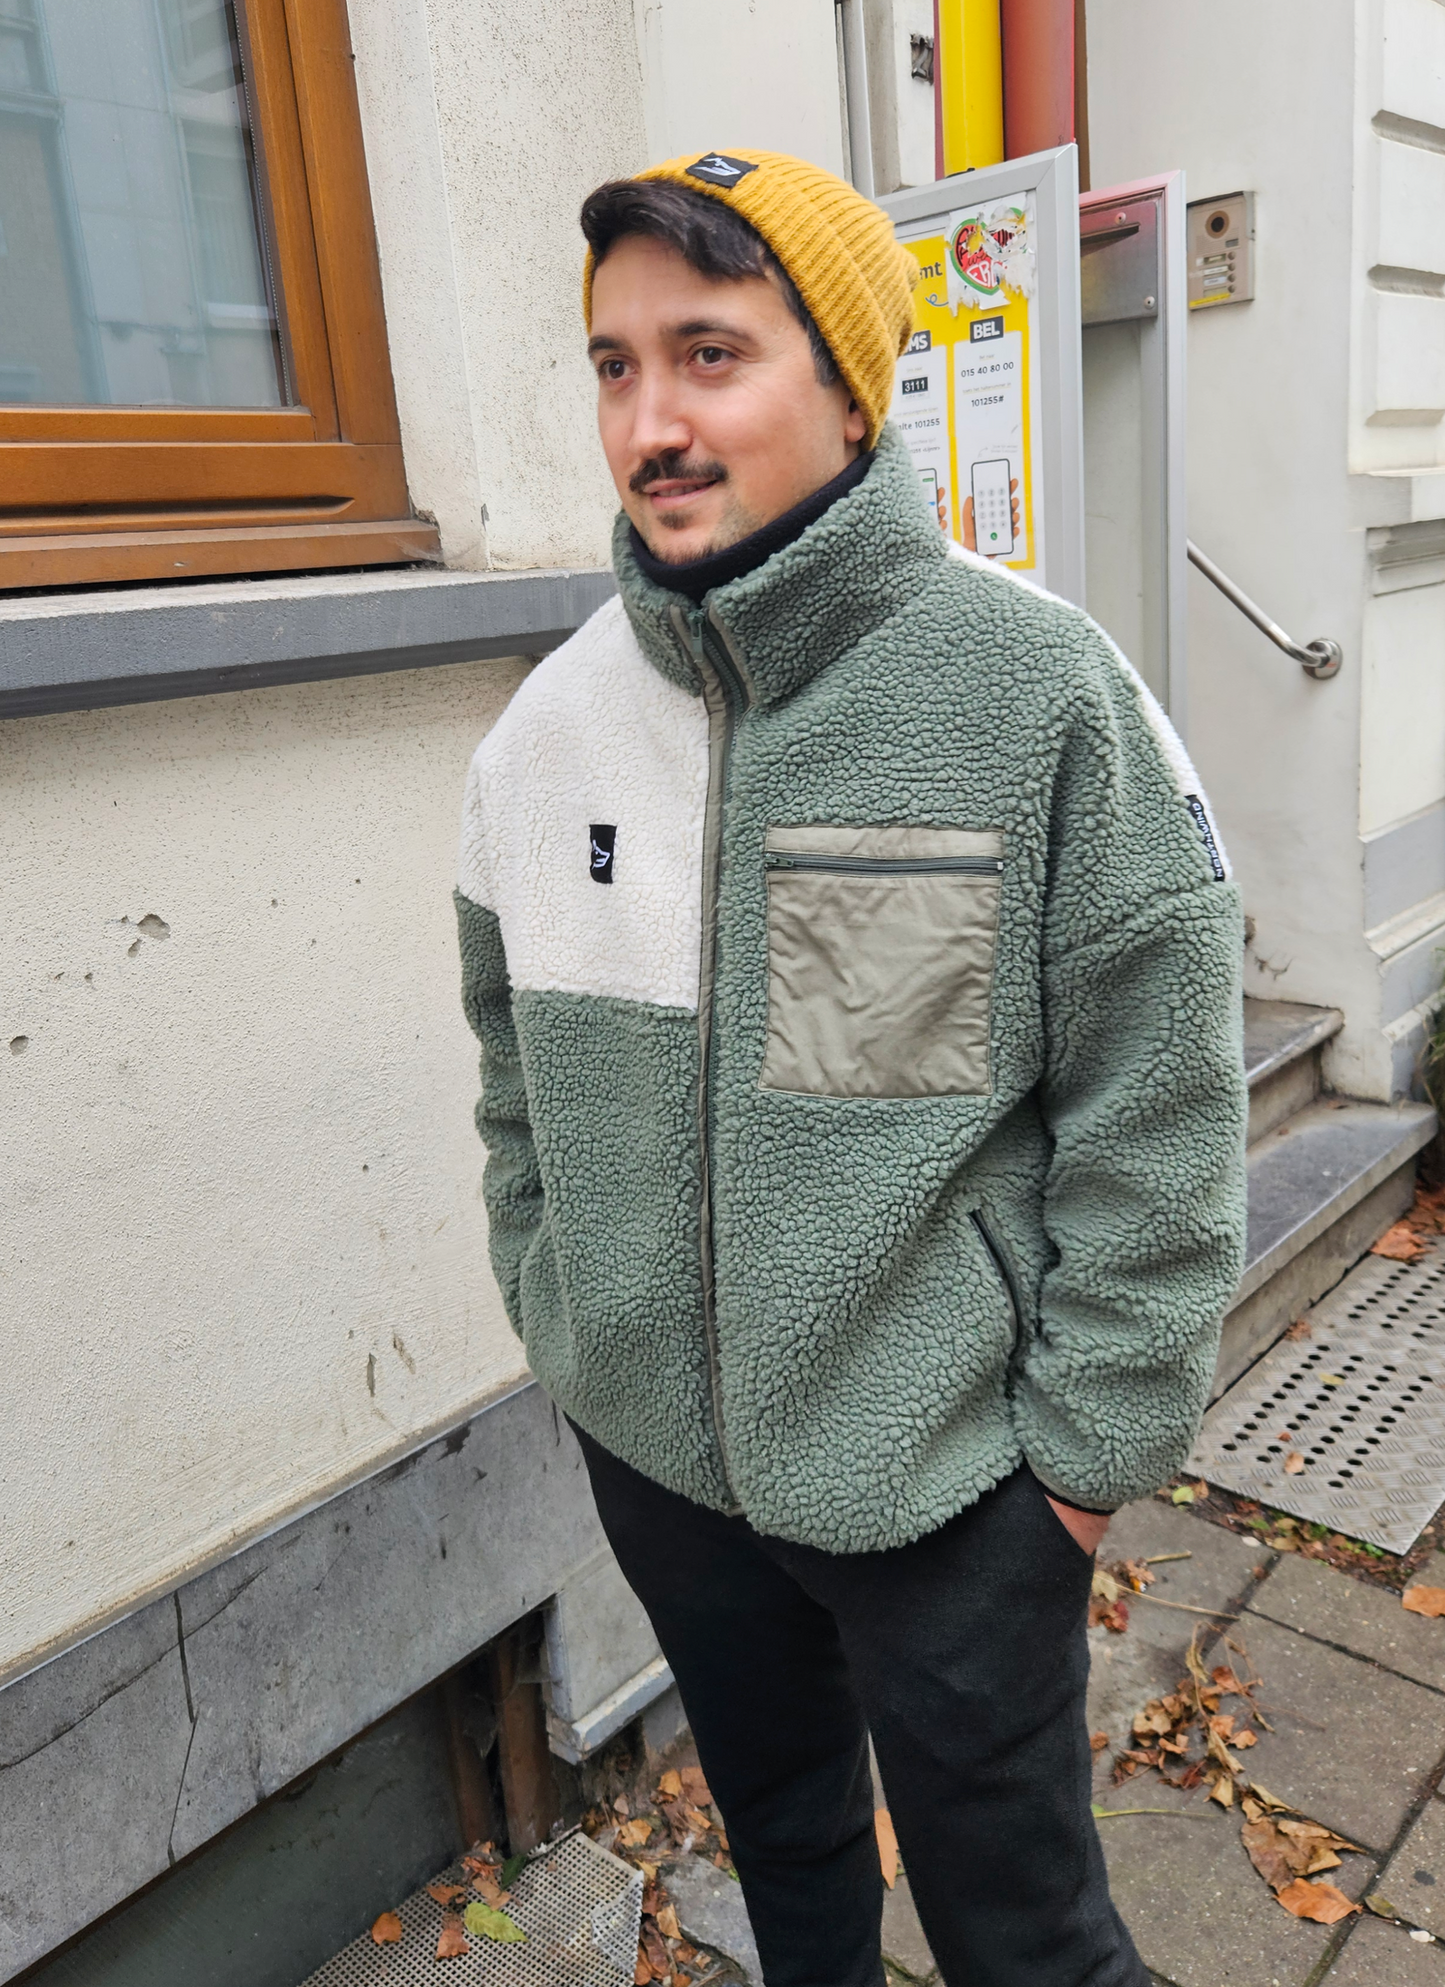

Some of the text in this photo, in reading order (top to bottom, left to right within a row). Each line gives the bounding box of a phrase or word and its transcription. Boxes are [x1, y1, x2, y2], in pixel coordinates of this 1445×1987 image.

[920, 261, 943, 280] mt
[973, 321, 1000, 340] BEL
[908, 334, 928, 352] MS
[960, 361, 1014, 378] 015 40 80 00
[904, 379, 925, 392] 3111
[971, 395, 1004, 407] 101255#
[914, 417, 940, 429] 101255
[1192, 802, 1223, 878] NORTHWIND
